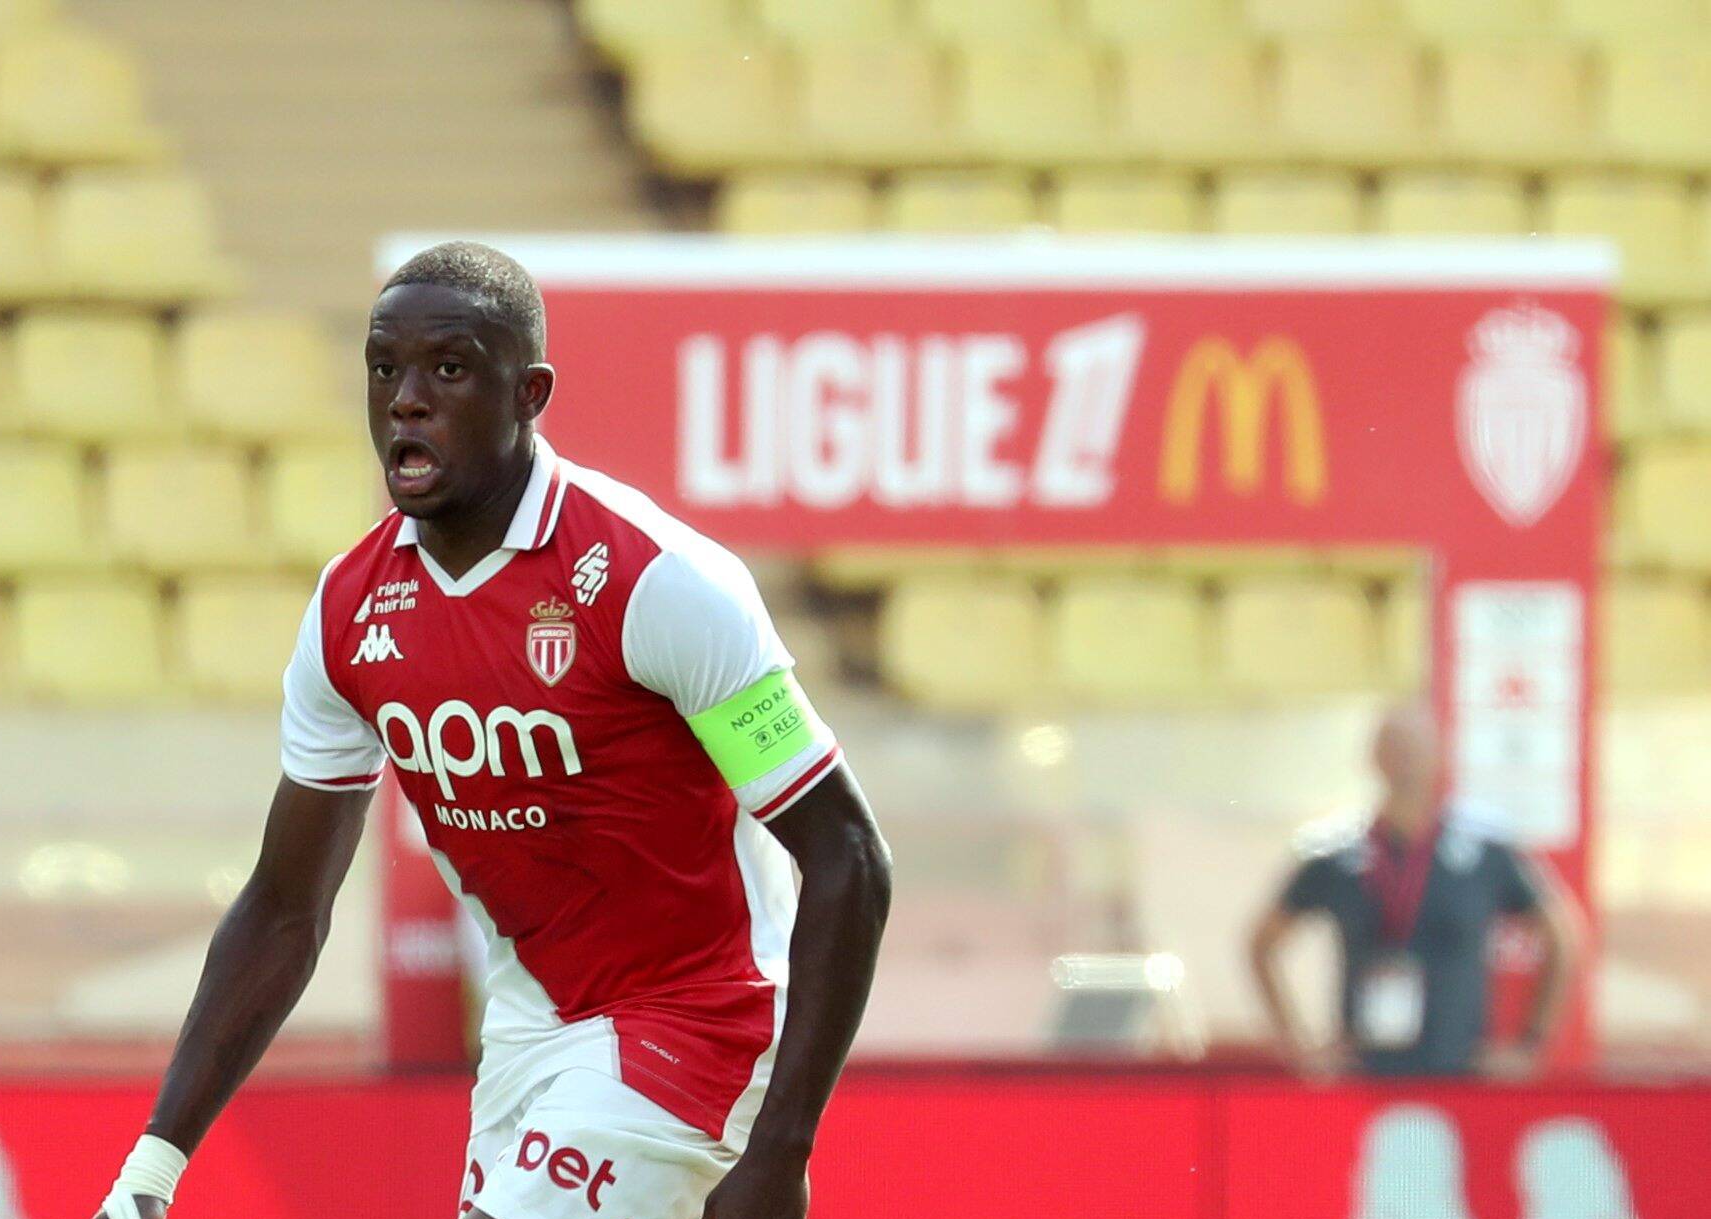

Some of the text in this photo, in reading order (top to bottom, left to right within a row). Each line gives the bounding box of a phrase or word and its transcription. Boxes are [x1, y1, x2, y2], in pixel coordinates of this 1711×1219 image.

[678, 332, 1028, 508] LIGUE
[730, 711, 754, 731] NO
[753, 698, 773, 715] TO
[377, 700, 582, 800] apm
[435, 803, 547, 831] MONACO
